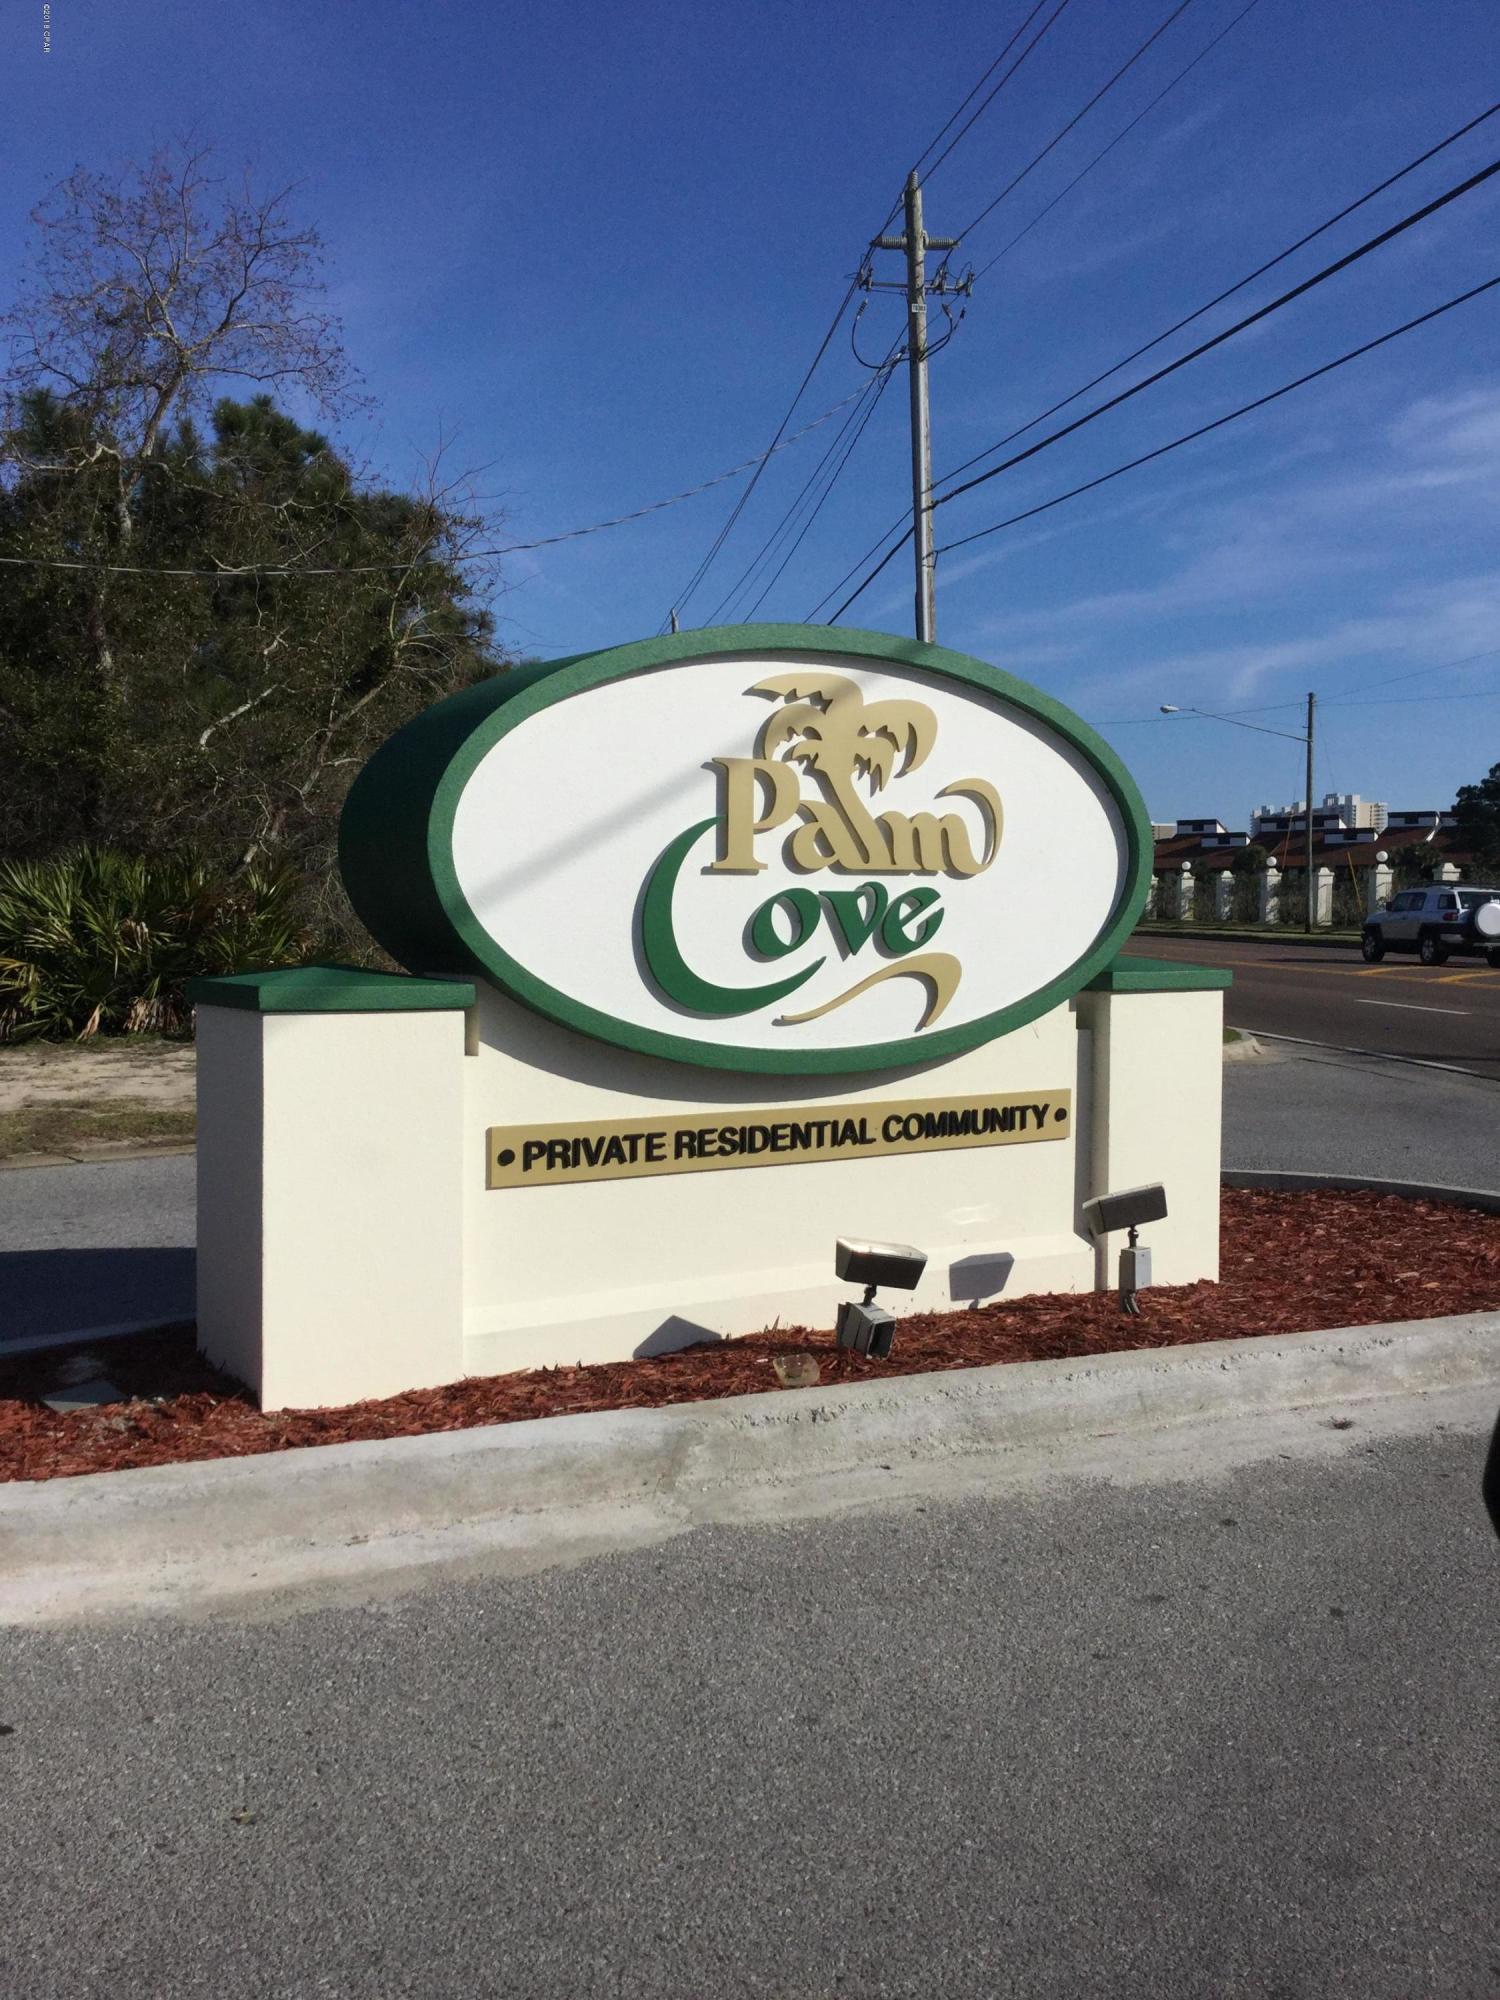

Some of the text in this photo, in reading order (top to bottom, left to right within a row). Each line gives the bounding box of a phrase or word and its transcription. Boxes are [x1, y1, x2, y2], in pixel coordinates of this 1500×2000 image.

[710, 672, 1003, 875] Palm
[642, 815, 944, 1016] Cove
[522, 1103, 1050, 1172] PRIVATE RESIDENTIAL COMMUNITY
